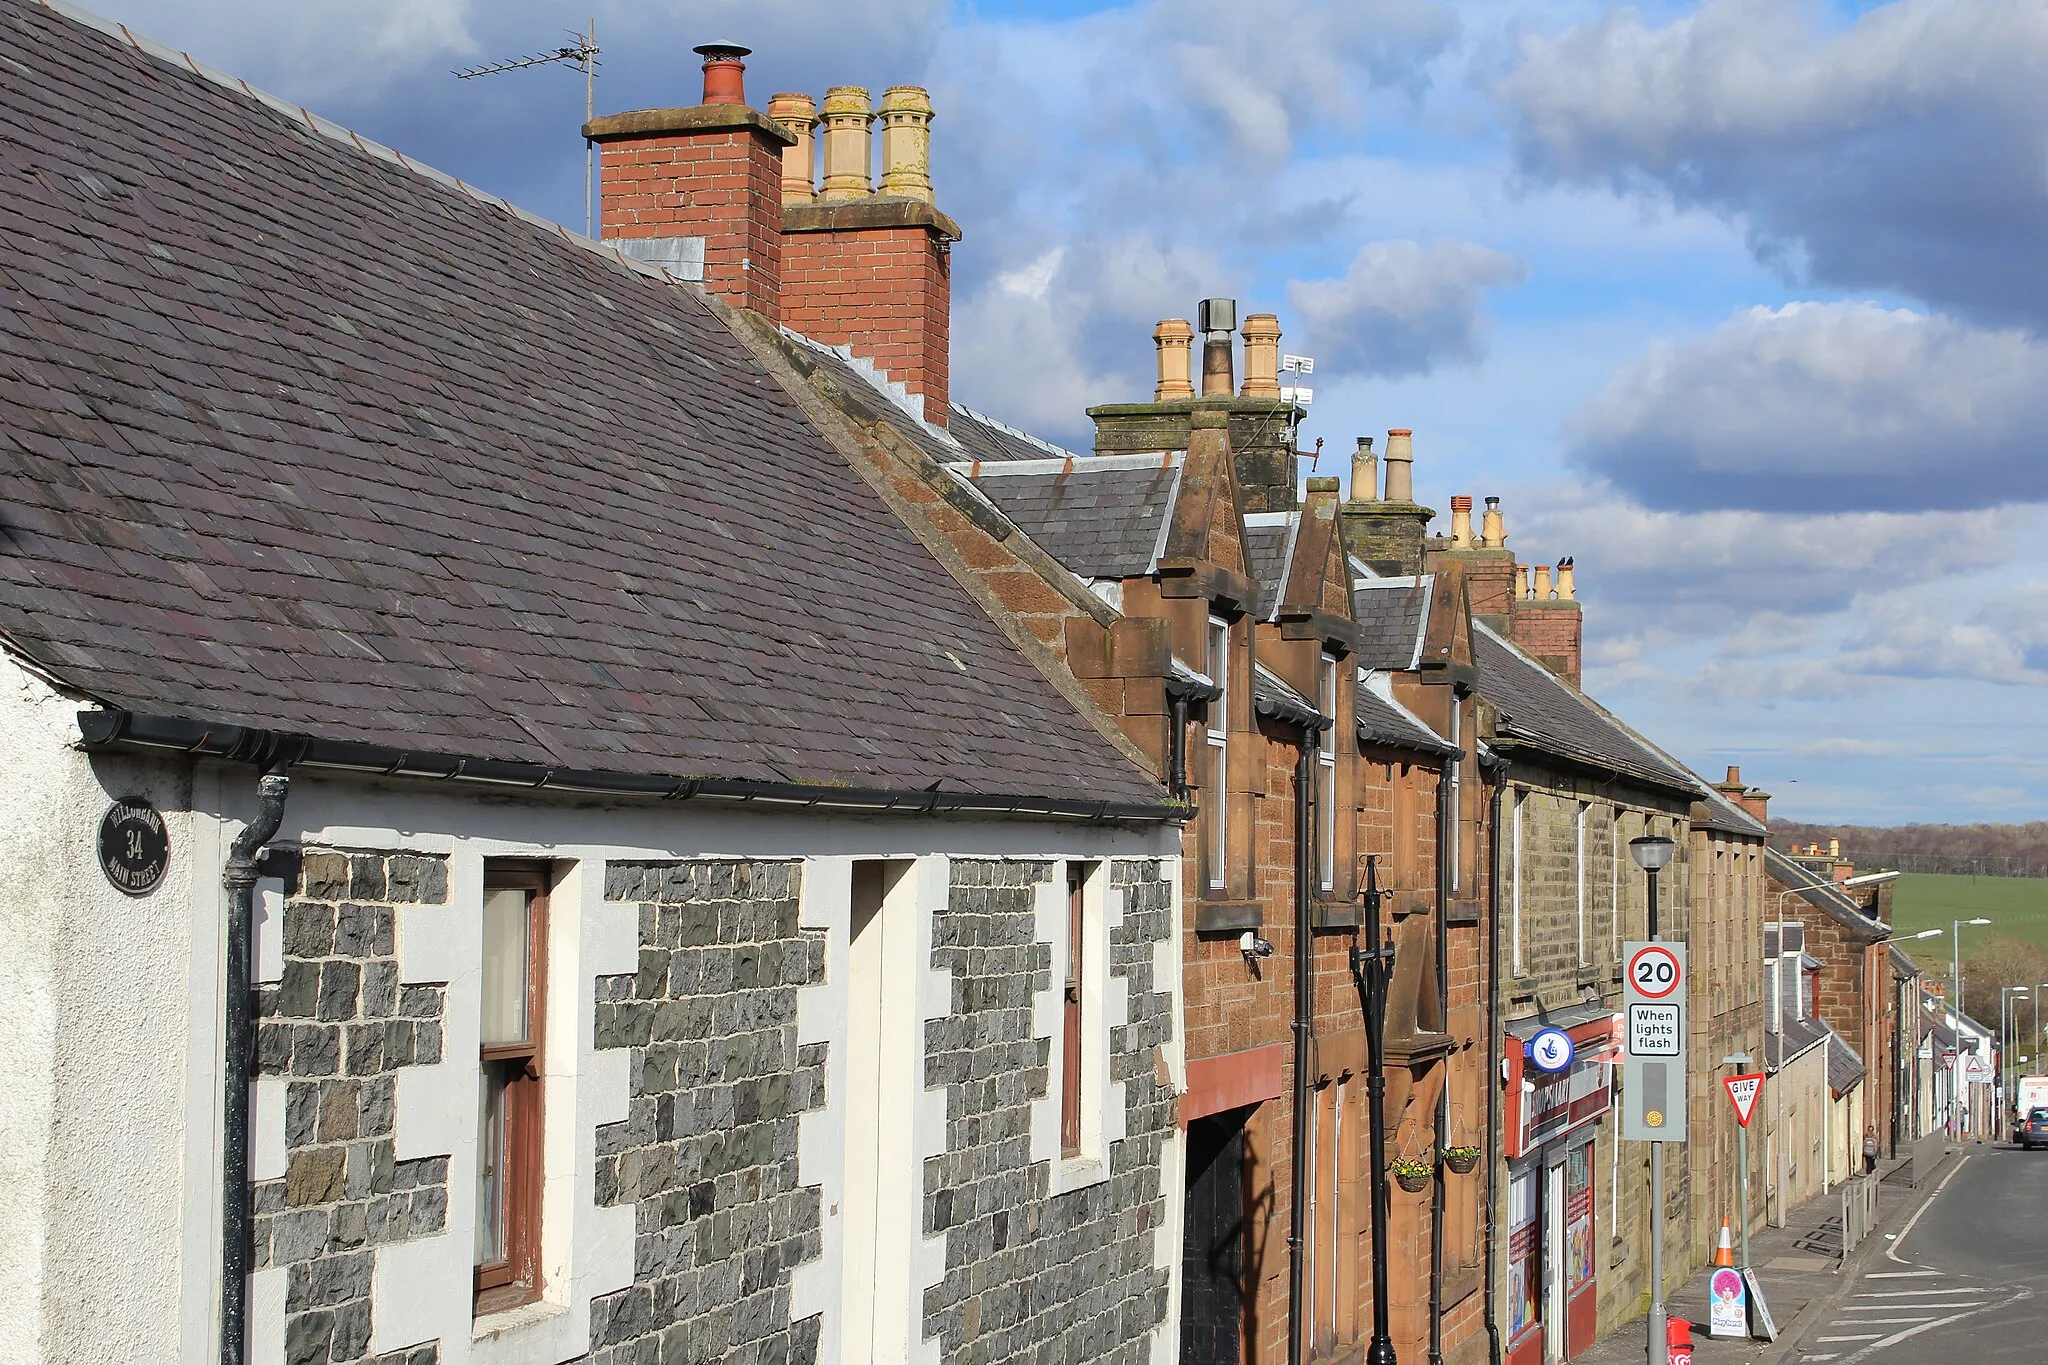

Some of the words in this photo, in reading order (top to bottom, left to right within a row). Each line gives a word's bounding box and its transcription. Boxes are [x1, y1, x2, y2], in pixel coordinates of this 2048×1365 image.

[126, 829, 144, 860] 34
[107, 856, 130, 885] MAIN
[130, 859, 161, 887] STREET
[1637, 962, 1673, 983] 20
[1636, 1010, 1673, 1021] When
[1636, 1023, 1673, 1036] lights
[1638, 1037, 1671, 1048] flash
[1732, 1080, 1755, 1093] GIVE
[1737, 1094, 1752, 1102] WAY
